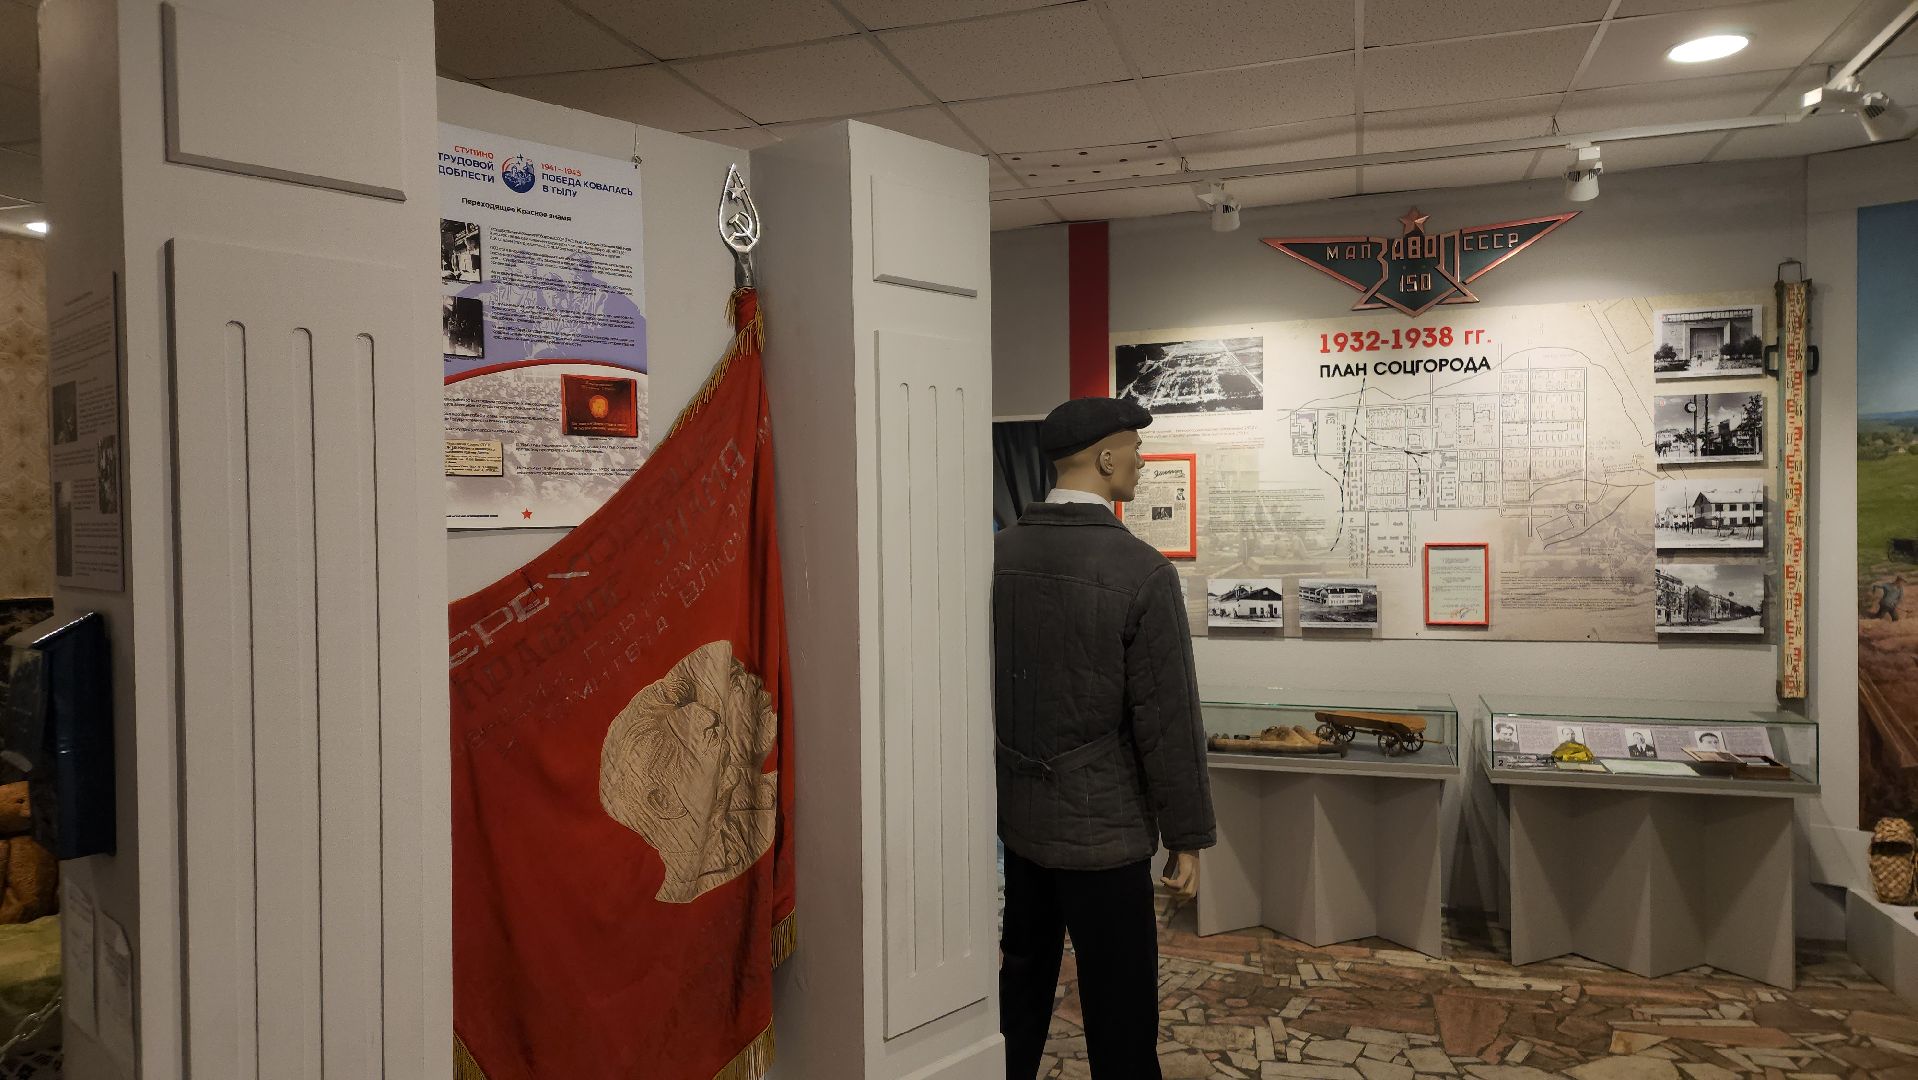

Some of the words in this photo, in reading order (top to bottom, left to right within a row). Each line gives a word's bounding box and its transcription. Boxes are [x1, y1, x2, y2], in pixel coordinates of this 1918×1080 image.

[438, 152, 494, 171] ТРУДОВОЙ
[454, 145, 494, 160] СТУПИНО
[438, 164, 495, 184] ДОБЛЕСТИ
[541, 173, 582, 188] ПОБЕДА
[583, 180, 634, 197] КОВАЛАСЬ
[542, 184, 549, 193] В
[550, 185, 578, 198] ТЫЛУ
[461, 197, 516, 214] Переходящее
[516, 207, 548, 219] Красное
[1326, 243, 1371, 261] МАП
[1463, 232, 1520, 252] СССР
[1399, 272, 1432, 293] 150
[1319, 325, 1454, 354] 1932-1938
[1319, 363, 1368, 379] ПЛАН
[1373, 356, 1491, 378] СОЦГОРОДА
